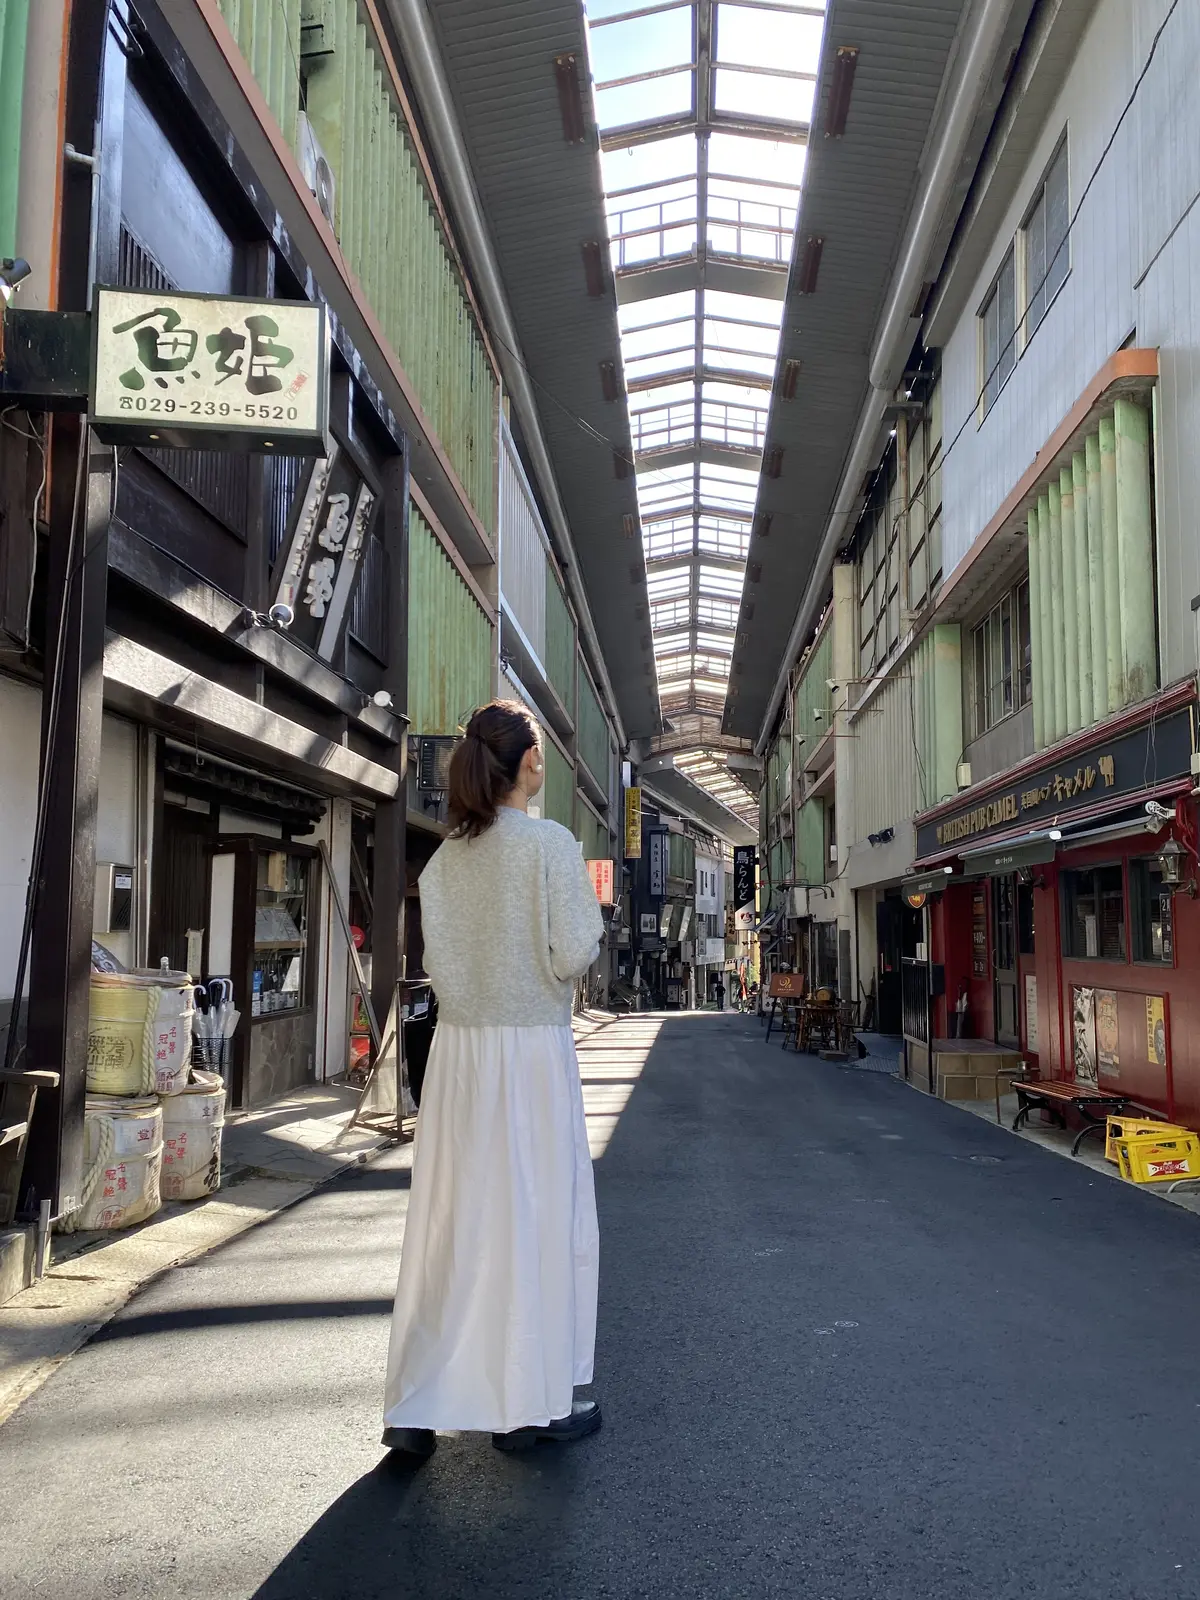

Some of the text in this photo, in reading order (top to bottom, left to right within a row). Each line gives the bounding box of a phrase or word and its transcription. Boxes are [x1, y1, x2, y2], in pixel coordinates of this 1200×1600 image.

[113, 307, 294, 395] 魚姫
[135, 397, 299, 421] 029-239-5520
[1053, 765, 1096, 803] キャメル
[943, 794, 1019, 844] BRITISH PUB CAMEL
[736, 851, 750, 901] 鳥らんど
